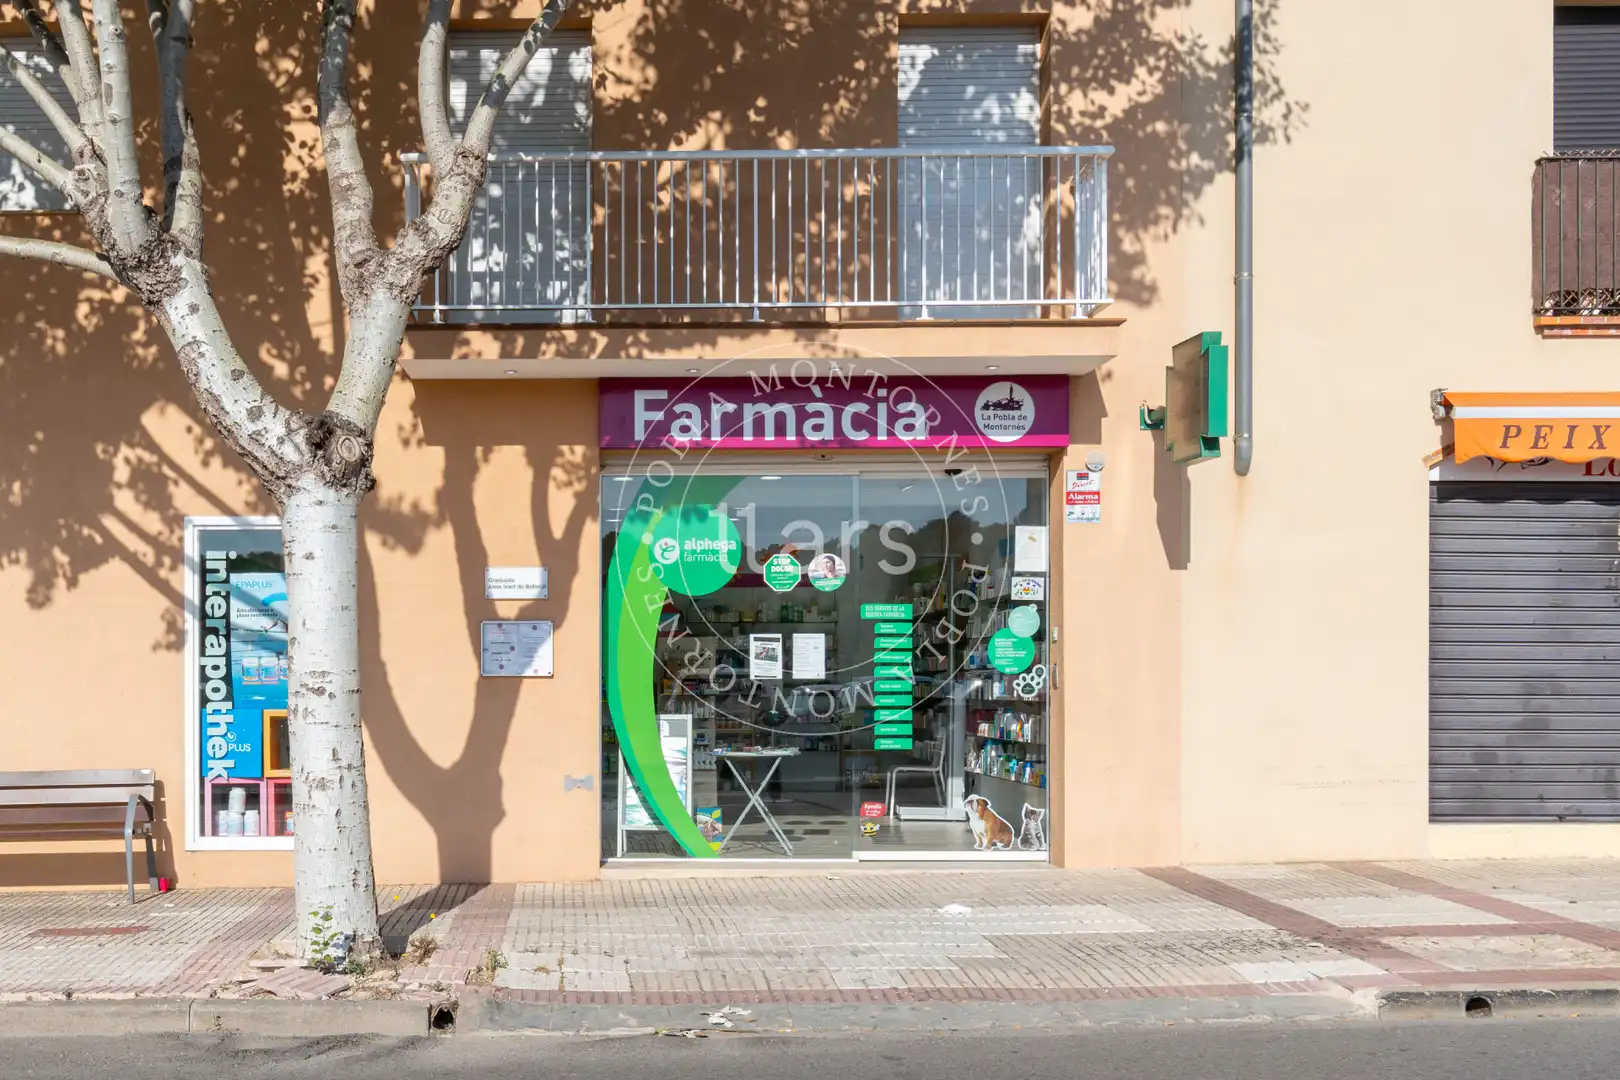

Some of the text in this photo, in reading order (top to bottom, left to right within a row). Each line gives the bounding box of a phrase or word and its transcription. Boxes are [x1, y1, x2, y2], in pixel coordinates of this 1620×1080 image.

[634, 385, 926, 442] Farmàcia
[981, 413, 1028, 421] La Pobla de
[983, 422, 1026, 431] Montornès
[1499, 424, 1612, 450] PEIX
[1068, 492, 1099, 500] Alarma
[683, 537, 737, 552] alphega
[683, 552, 728, 562] farmàcia
[235, 580, 273, 588] EPAPLUS
[200, 550, 237, 782] interapothek
